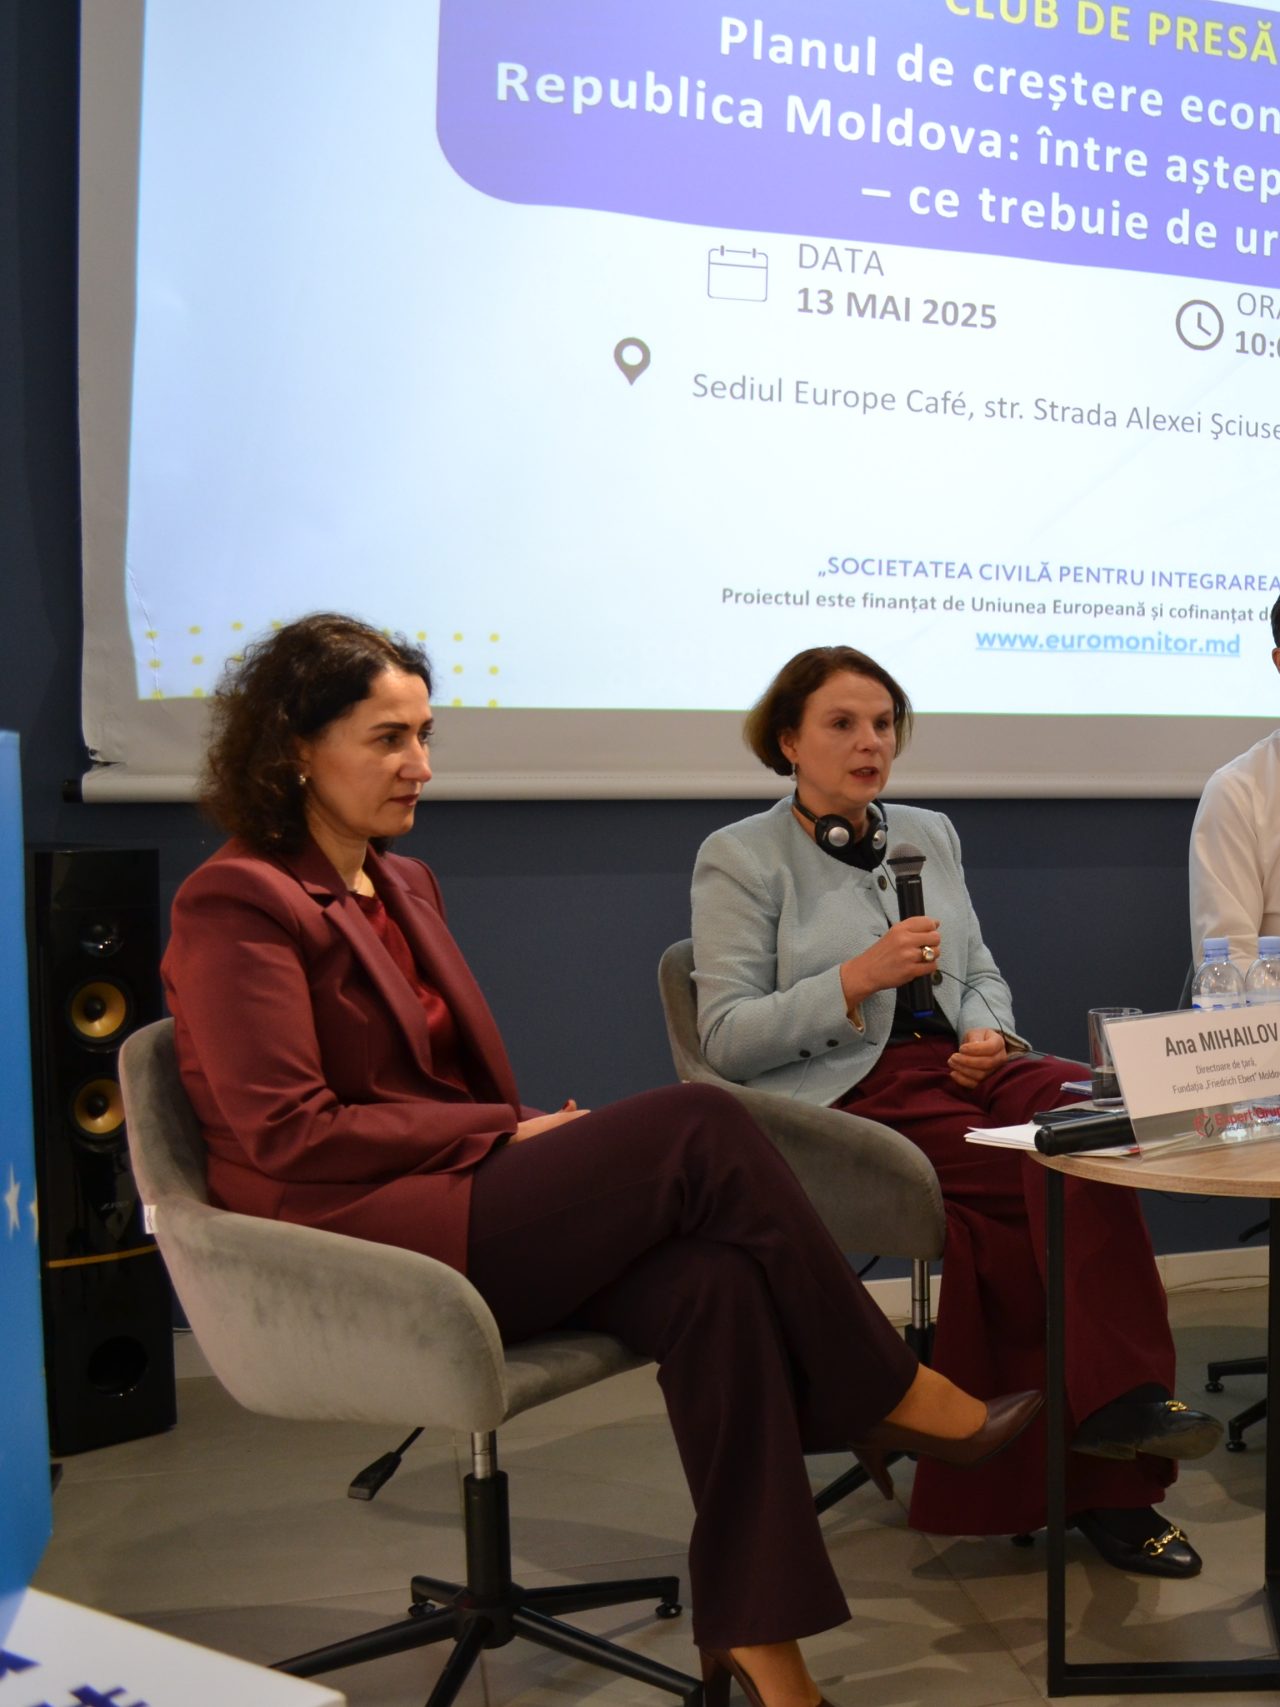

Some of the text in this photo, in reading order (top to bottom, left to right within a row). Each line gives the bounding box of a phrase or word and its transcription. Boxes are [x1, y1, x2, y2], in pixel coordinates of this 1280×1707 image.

[1077, 1, 1130, 41] DE
[1148, 11, 1278, 65] PRESĂ
[720, 16, 876, 76] Planul
[896, 43, 955, 87] de
[973, 62, 1164, 117] creștere
[495, 62, 763, 129] Republica
[786, 95, 1019, 161] Moldova:
[1036, 126, 1148, 177] între
[909, 186, 960, 218] ce
[978, 187, 1149, 240] trebuie
[1166, 208, 1217, 249] de
[798, 243, 885, 276] DATA
[797, 287, 997, 329] 13 MAI 2025
[692, 373, 783, 402] Sediul
[795, 380, 896, 415] Europe
[906, 390, 975, 422] Café,
[984, 396, 1024, 419] str.
[1033, 397, 1117, 428] Strada
[1125, 406, 1202, 434] Alexei
[979, 562, 1052, 582] CIVILĂ
[1059, 565, 1144, 587] PENTRU
[722, 587, 810, 606] Proiectul
[815, 593, 856, 607] este
[861, 592, 936, 613] finanțat
[942, 595, 966, 611] de
[971, 597, 1046, 615] Uniunea
[1052, 600, 1146, 617] Europeană
[1151, 604, 1163, 620] și
[1169, 604, 1254, 623] cofinanțat
[1259, 606, 1272, 622] d
[975, 630, 1241, 656] www.euromonitor.md
[1165, 1022, 1279, 1057] Ana MIHAILOV
[1195, 1062, 1231, 1075] Directoare
[1232, 1060, 1241, 1070] de
